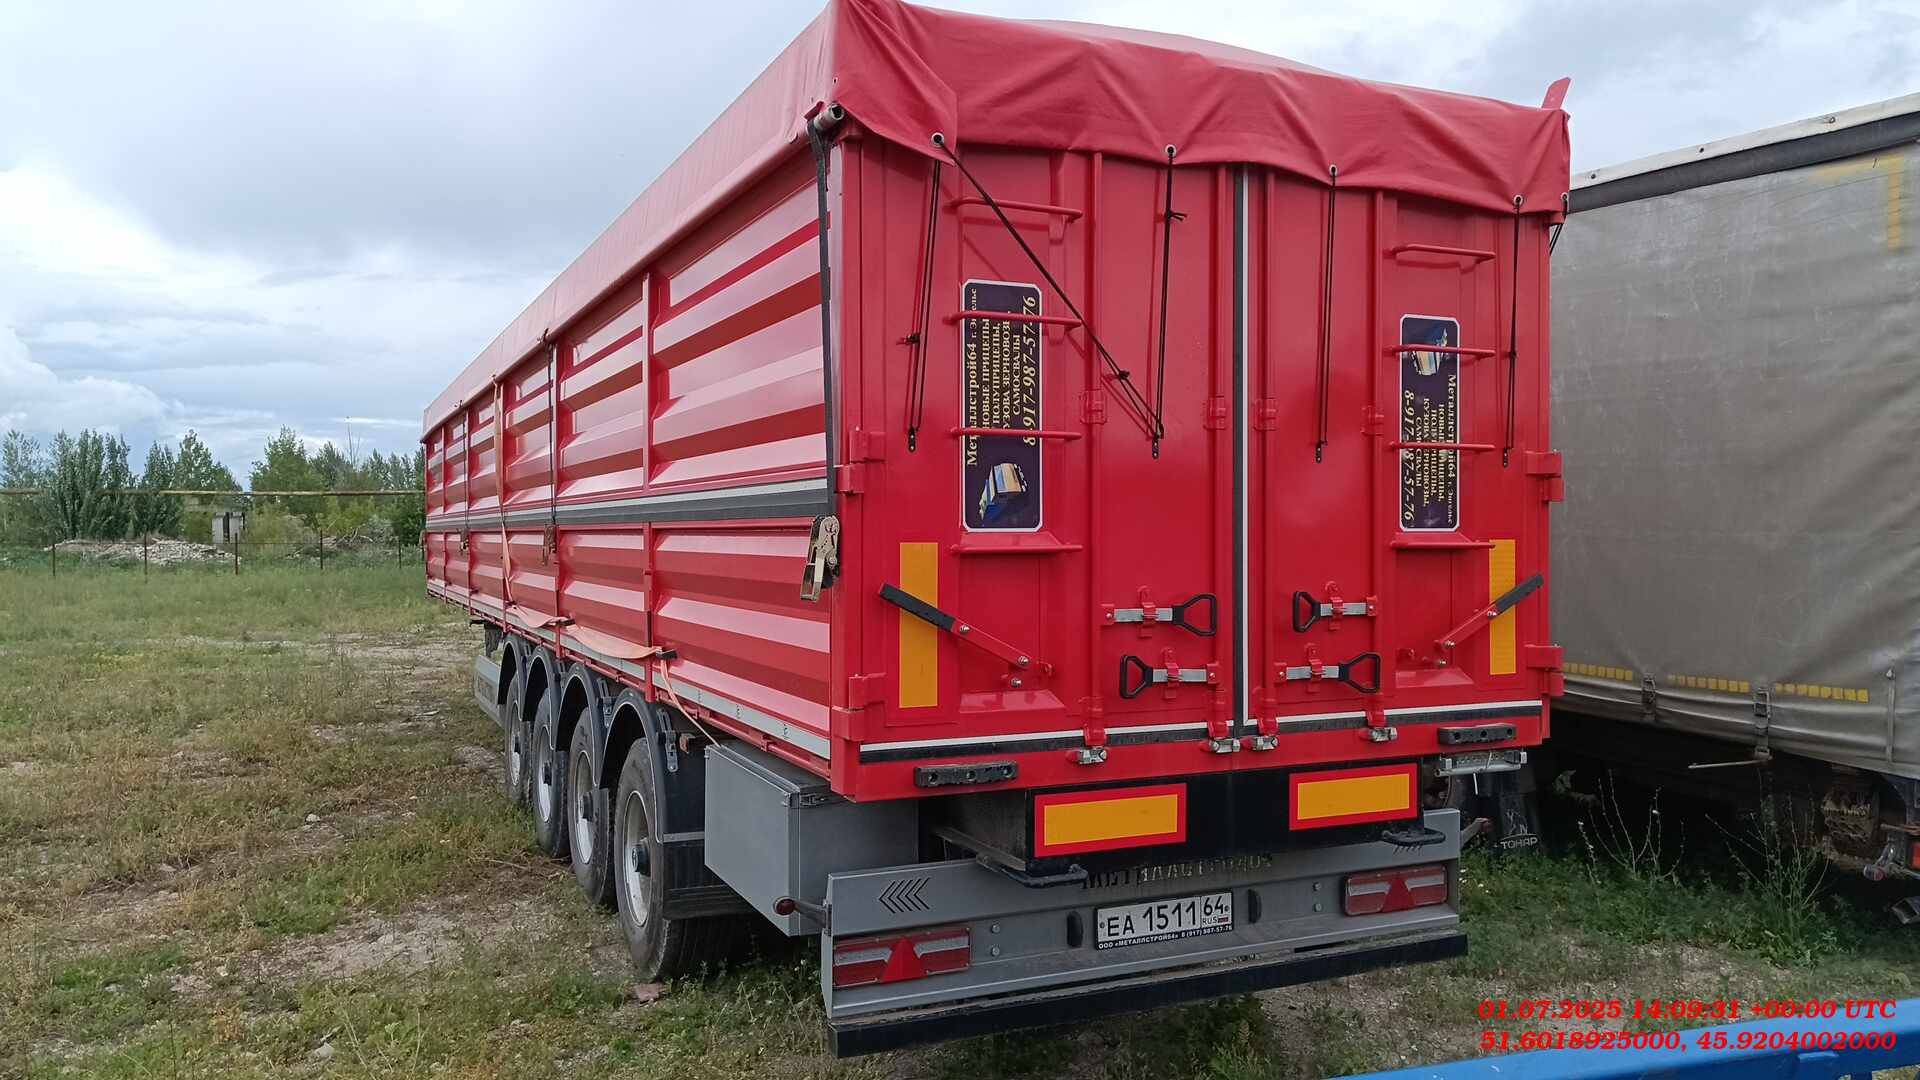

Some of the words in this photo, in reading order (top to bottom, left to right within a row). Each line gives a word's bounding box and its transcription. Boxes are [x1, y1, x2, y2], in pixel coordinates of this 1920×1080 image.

[969, 288, 977, 329] Эельс
[992, 322, 1001, 424] ПОЛУПРИЦЕПЫ,
[1012, 334, 1021, 415] САМОСВАЛЫ
[982, 384, 990, 429] НОВЫЕ
[1002, 390, 1010, 430] УЗОВА
[1404, 390, 1415, 521] 8-917-87-57-76
[1422, 442, 1430, 507] ЕРНОВОЗЫ,
[1500, 837, 1538, 849] ТОНАР
[1107, 914, 1135, 937] ЕА
[1142, 901, 1196, 932] 1511
[1203, 896, 1225, 917] 64
[1202, 916, 1217, 925] RUS
